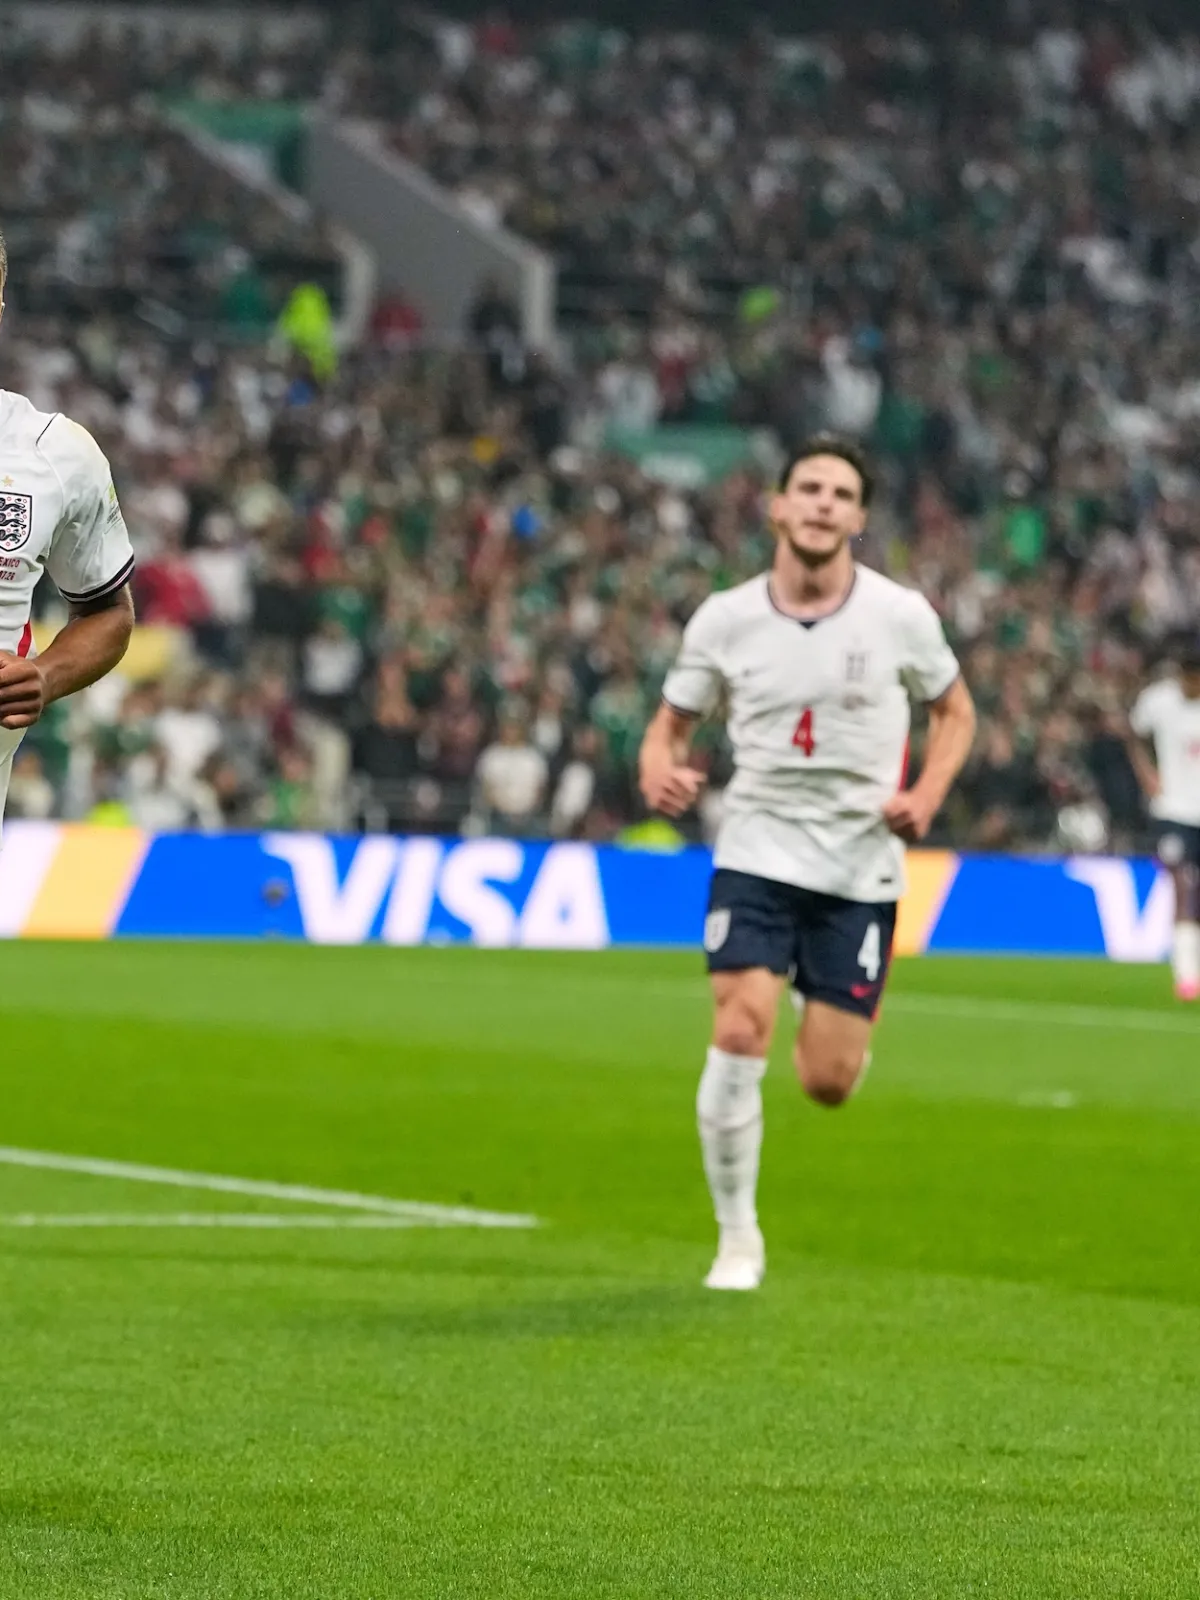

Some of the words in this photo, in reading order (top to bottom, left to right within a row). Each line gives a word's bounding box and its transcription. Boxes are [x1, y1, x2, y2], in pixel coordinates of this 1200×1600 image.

[791, 708, 816, 757] 4
[260, 832, 611, 948] VISA
[857, 922, 880, 982] 4
